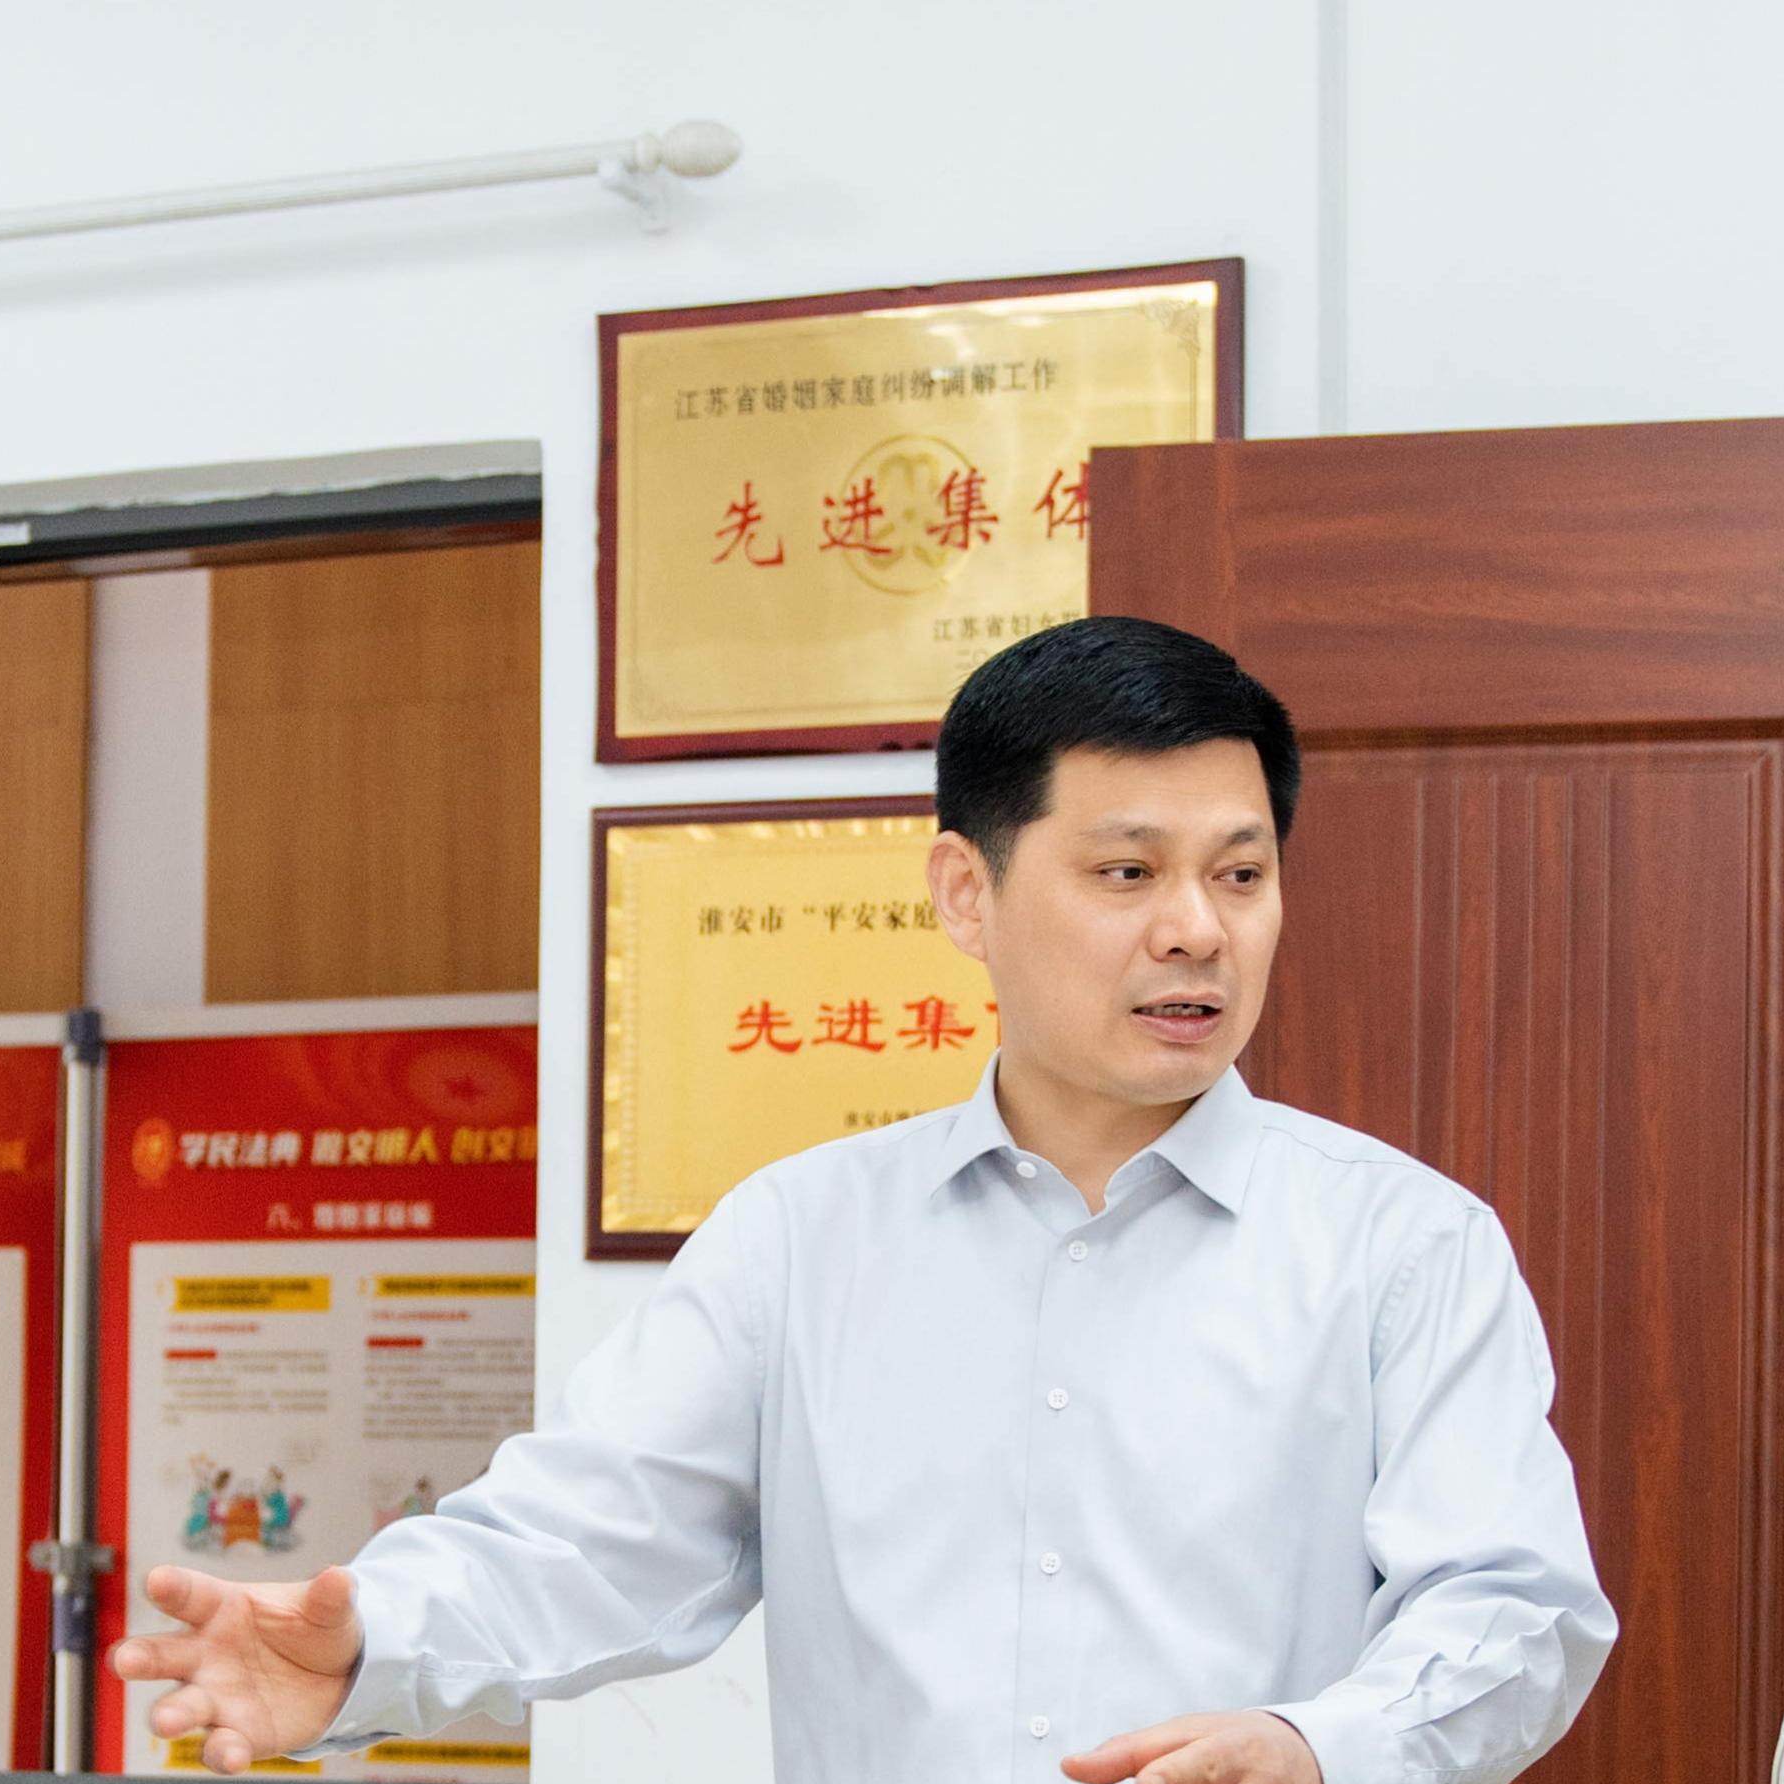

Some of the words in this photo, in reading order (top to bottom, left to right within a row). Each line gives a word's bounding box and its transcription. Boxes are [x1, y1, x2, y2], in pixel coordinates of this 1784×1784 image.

[674, 357, 1059, 421] 江苏省婚姻家庭纠纷调解工作
